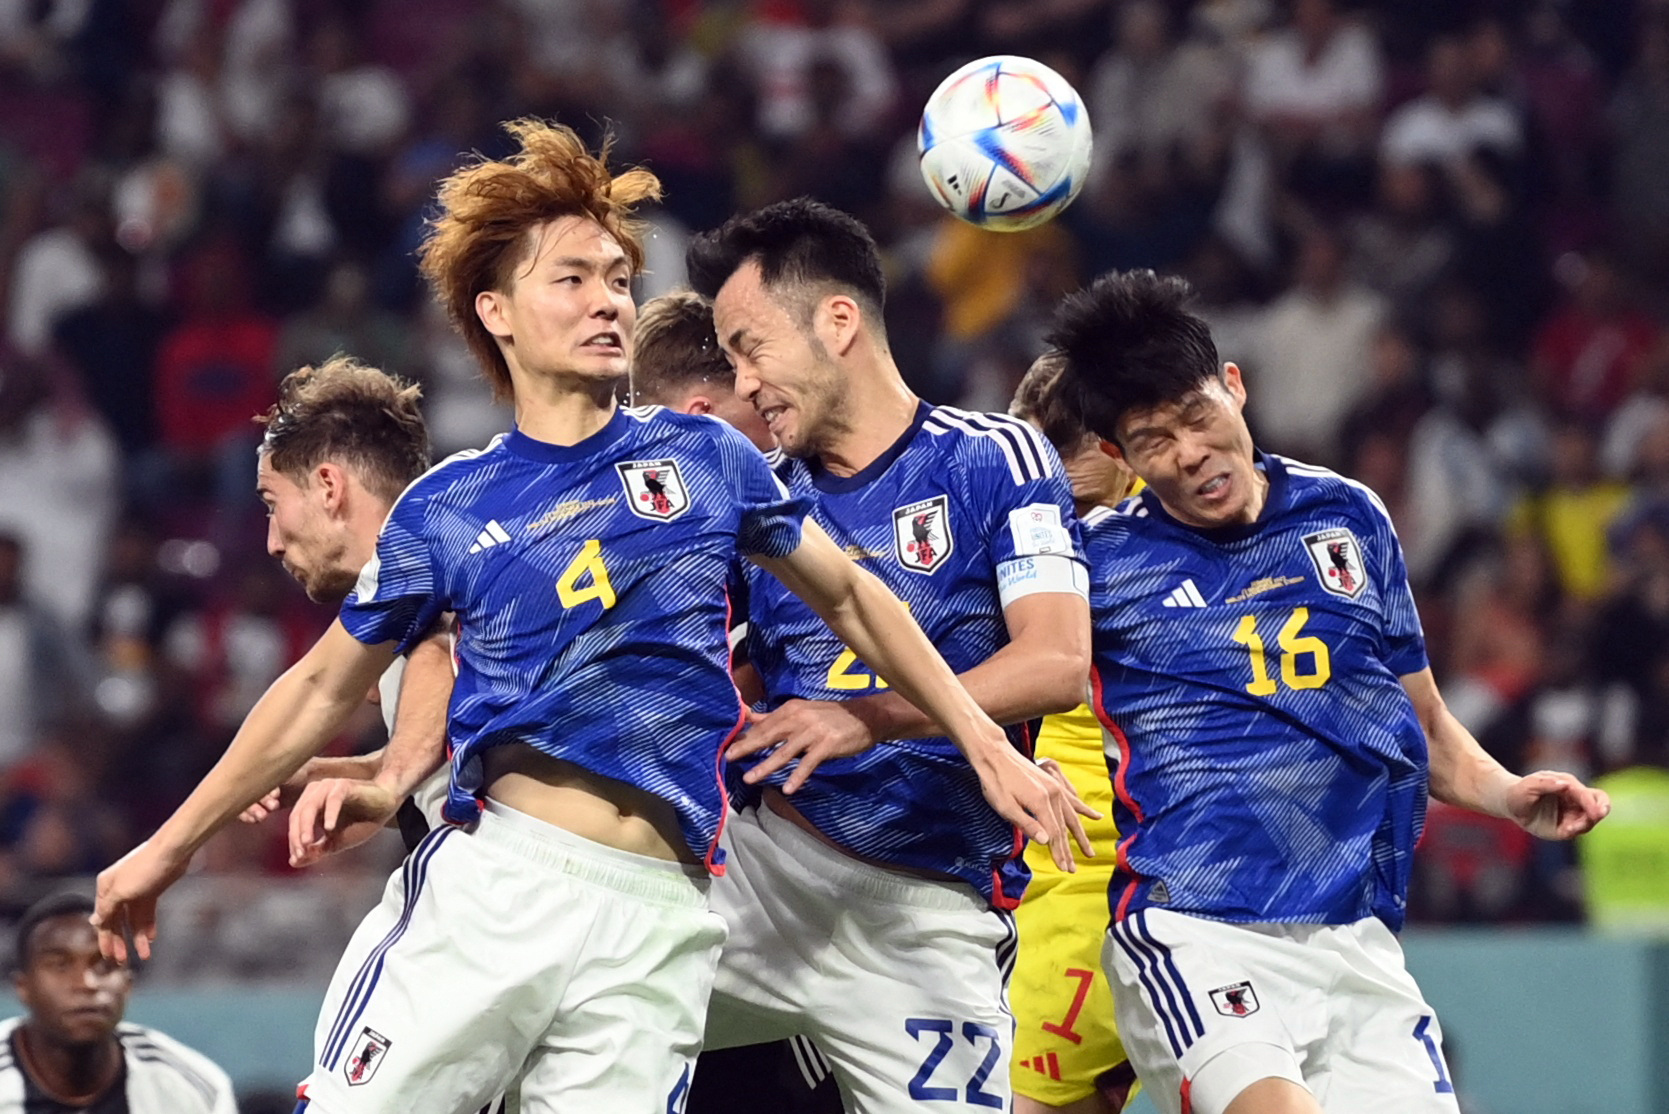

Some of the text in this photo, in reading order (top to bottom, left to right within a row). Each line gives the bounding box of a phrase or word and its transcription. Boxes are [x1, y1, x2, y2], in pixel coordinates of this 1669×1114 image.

[905, 501, 933, 515] JAPAN
[555, 539, 617, 610] 4
[1232, 606, 1331, 697] 16
[1041, 967, 1095, 1046] 1
[904, 1017, 1003, 1111] 22
